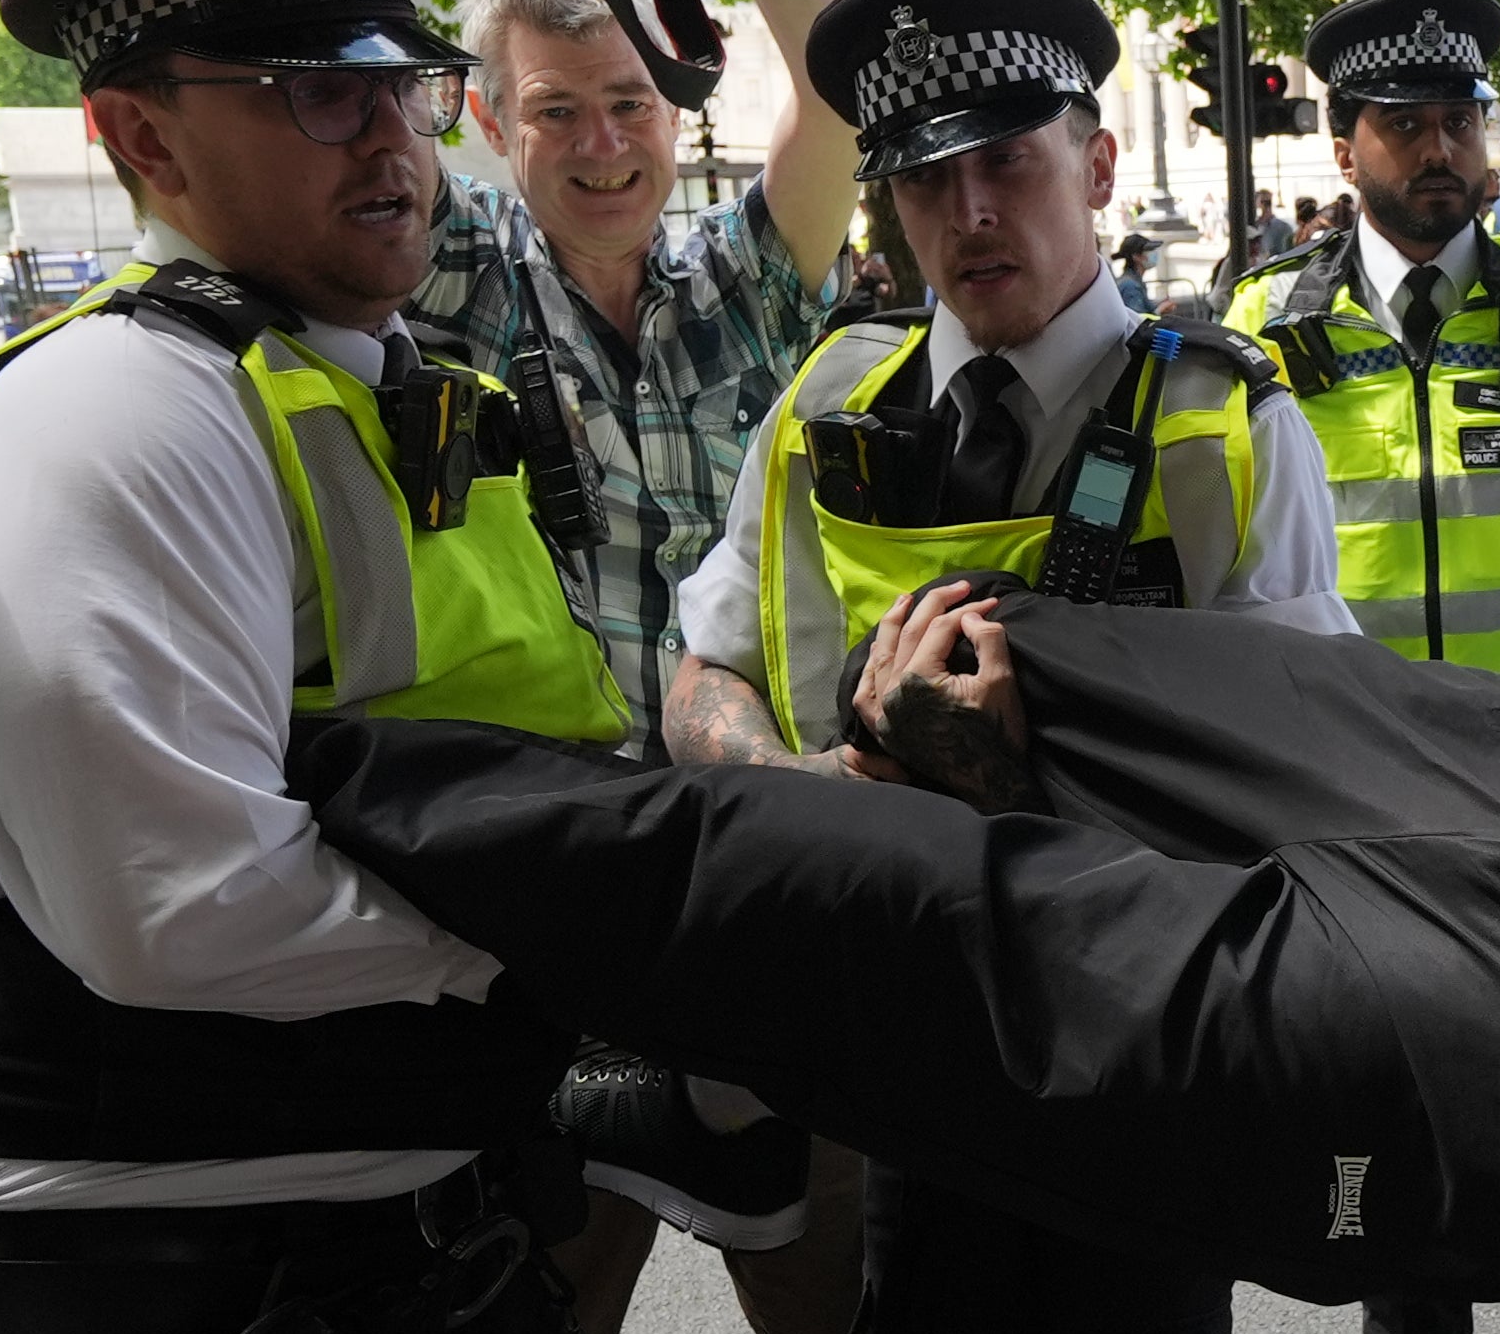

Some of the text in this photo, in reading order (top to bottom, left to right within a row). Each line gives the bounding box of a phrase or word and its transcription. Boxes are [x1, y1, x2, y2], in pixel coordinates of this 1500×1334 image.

[173, 275, 243, 306] 2727
[1464, 452, 1499, 465] POLICE
[1115, 590, 1167, 604] ROPOLITAN
[1326, 1154, 1373, 1240] LONSDALE
